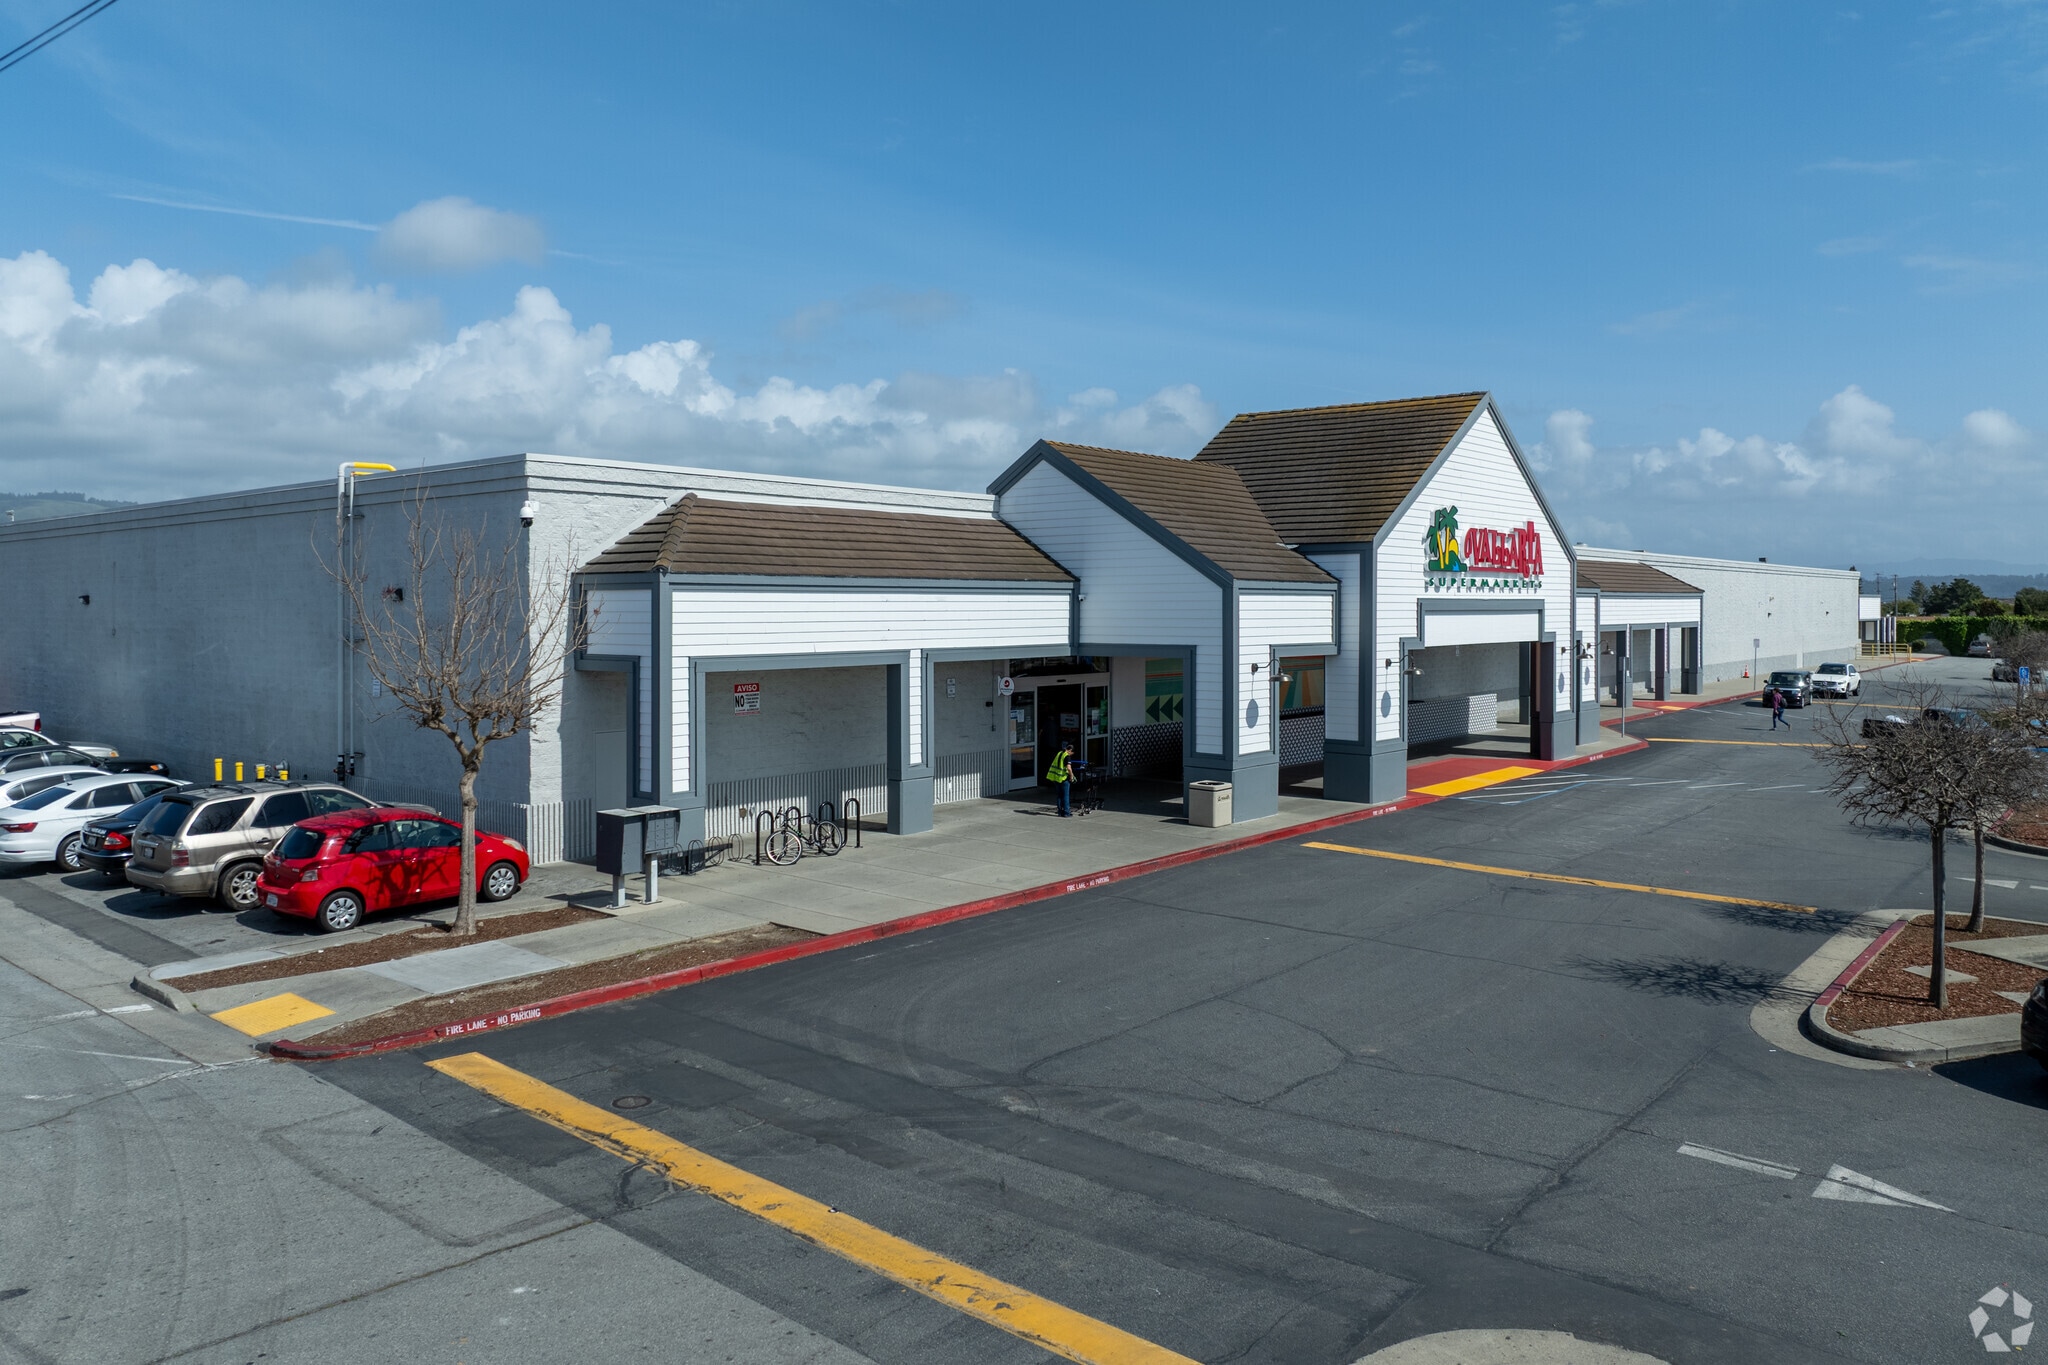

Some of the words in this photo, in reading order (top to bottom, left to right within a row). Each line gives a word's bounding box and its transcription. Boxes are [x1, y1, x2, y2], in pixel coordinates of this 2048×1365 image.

[1428, 577, 1542, 589] SUPERMARKETS
[737, 684, 757, 692] AVISO
[735, 695, 744, 707] NO
[446, 1025, 464, 1035] FIRE
[467, 1019, 487, 1031] LANE
[497, 1015, 508, 1025] NO
[510, 1008, 541, 1022] PARKING
